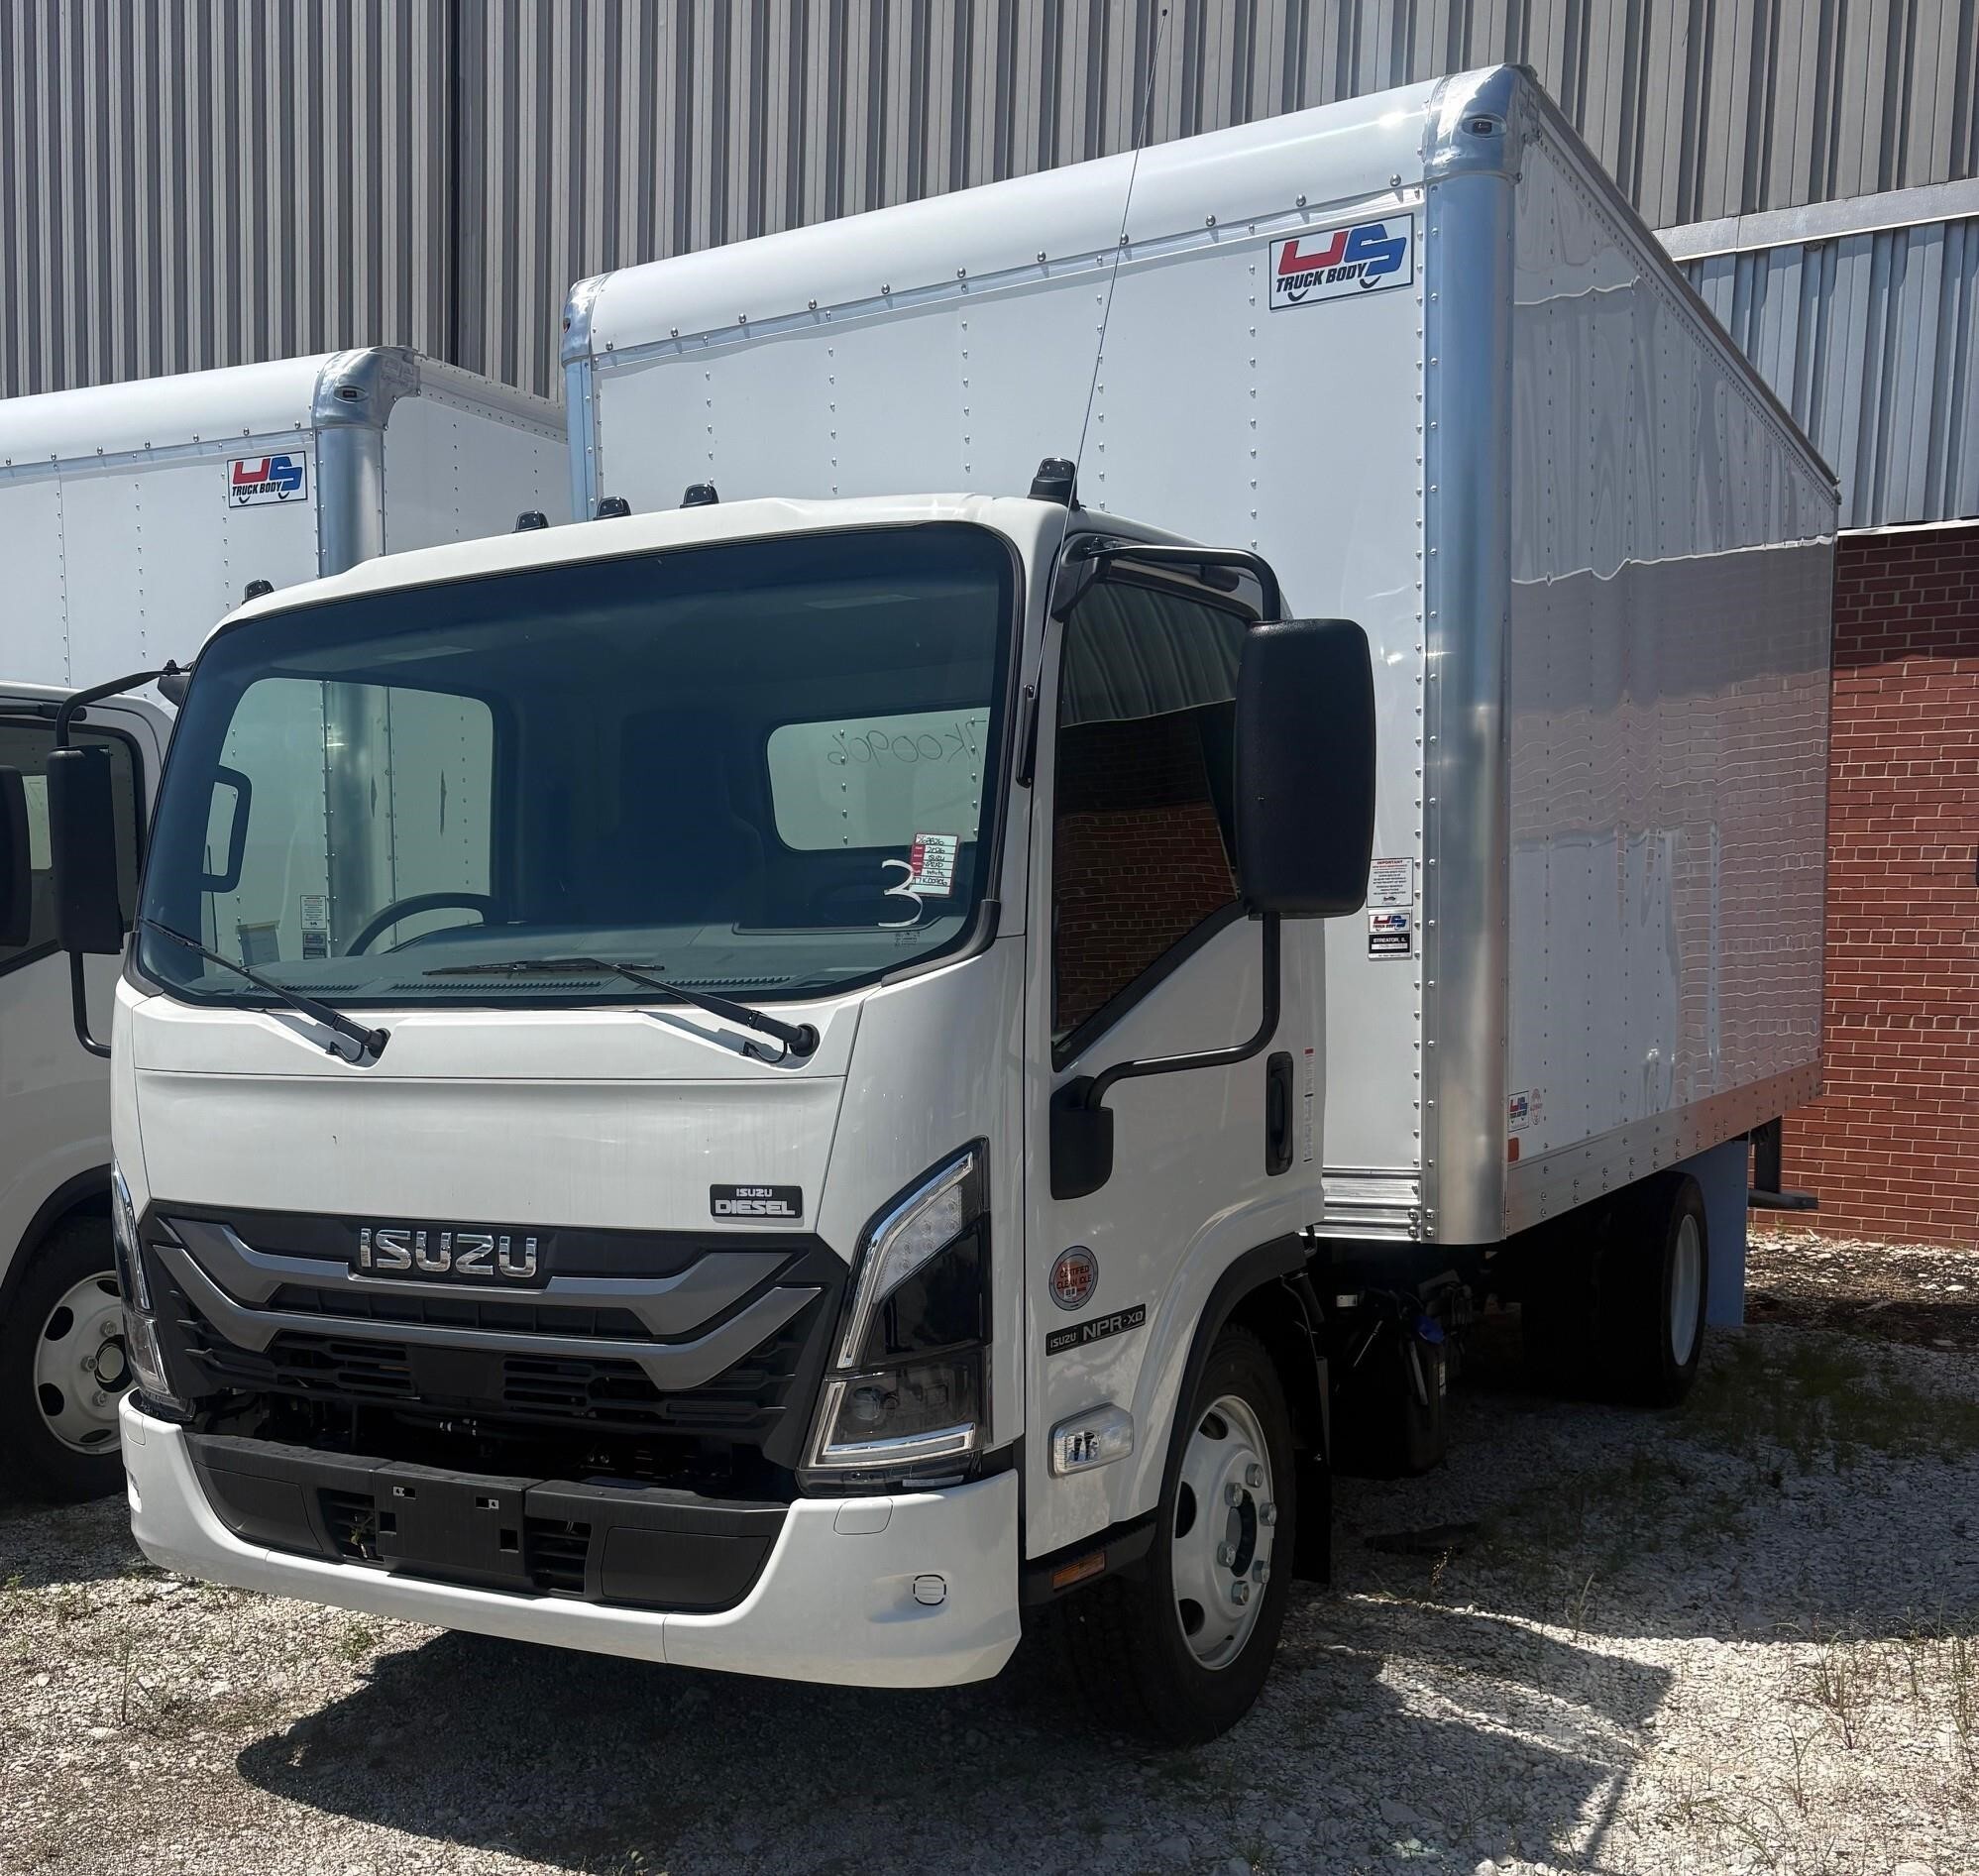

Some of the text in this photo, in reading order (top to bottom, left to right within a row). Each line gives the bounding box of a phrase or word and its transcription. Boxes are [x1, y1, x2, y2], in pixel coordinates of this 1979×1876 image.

[1277, 223, 1407, 277] US
[1275, 262, 1369, 293] TRUCK BODY
[233, 456, 303, 492] US
[232, 482, 282, 497] TRUCK BODY
[877, 858, 924, 928] 3
[735, 1187, 773, 1197] ISUZU
[715, 1199, 796, 1216] DIESEL
[360, 1227, 538, 1278] ISUZU
[1056, 1278, 1078, 1290] CLEAN
[1079, 1274, 1092, 1284] IDLE
[1050, 1331, 1077, 1349] ISUZU
